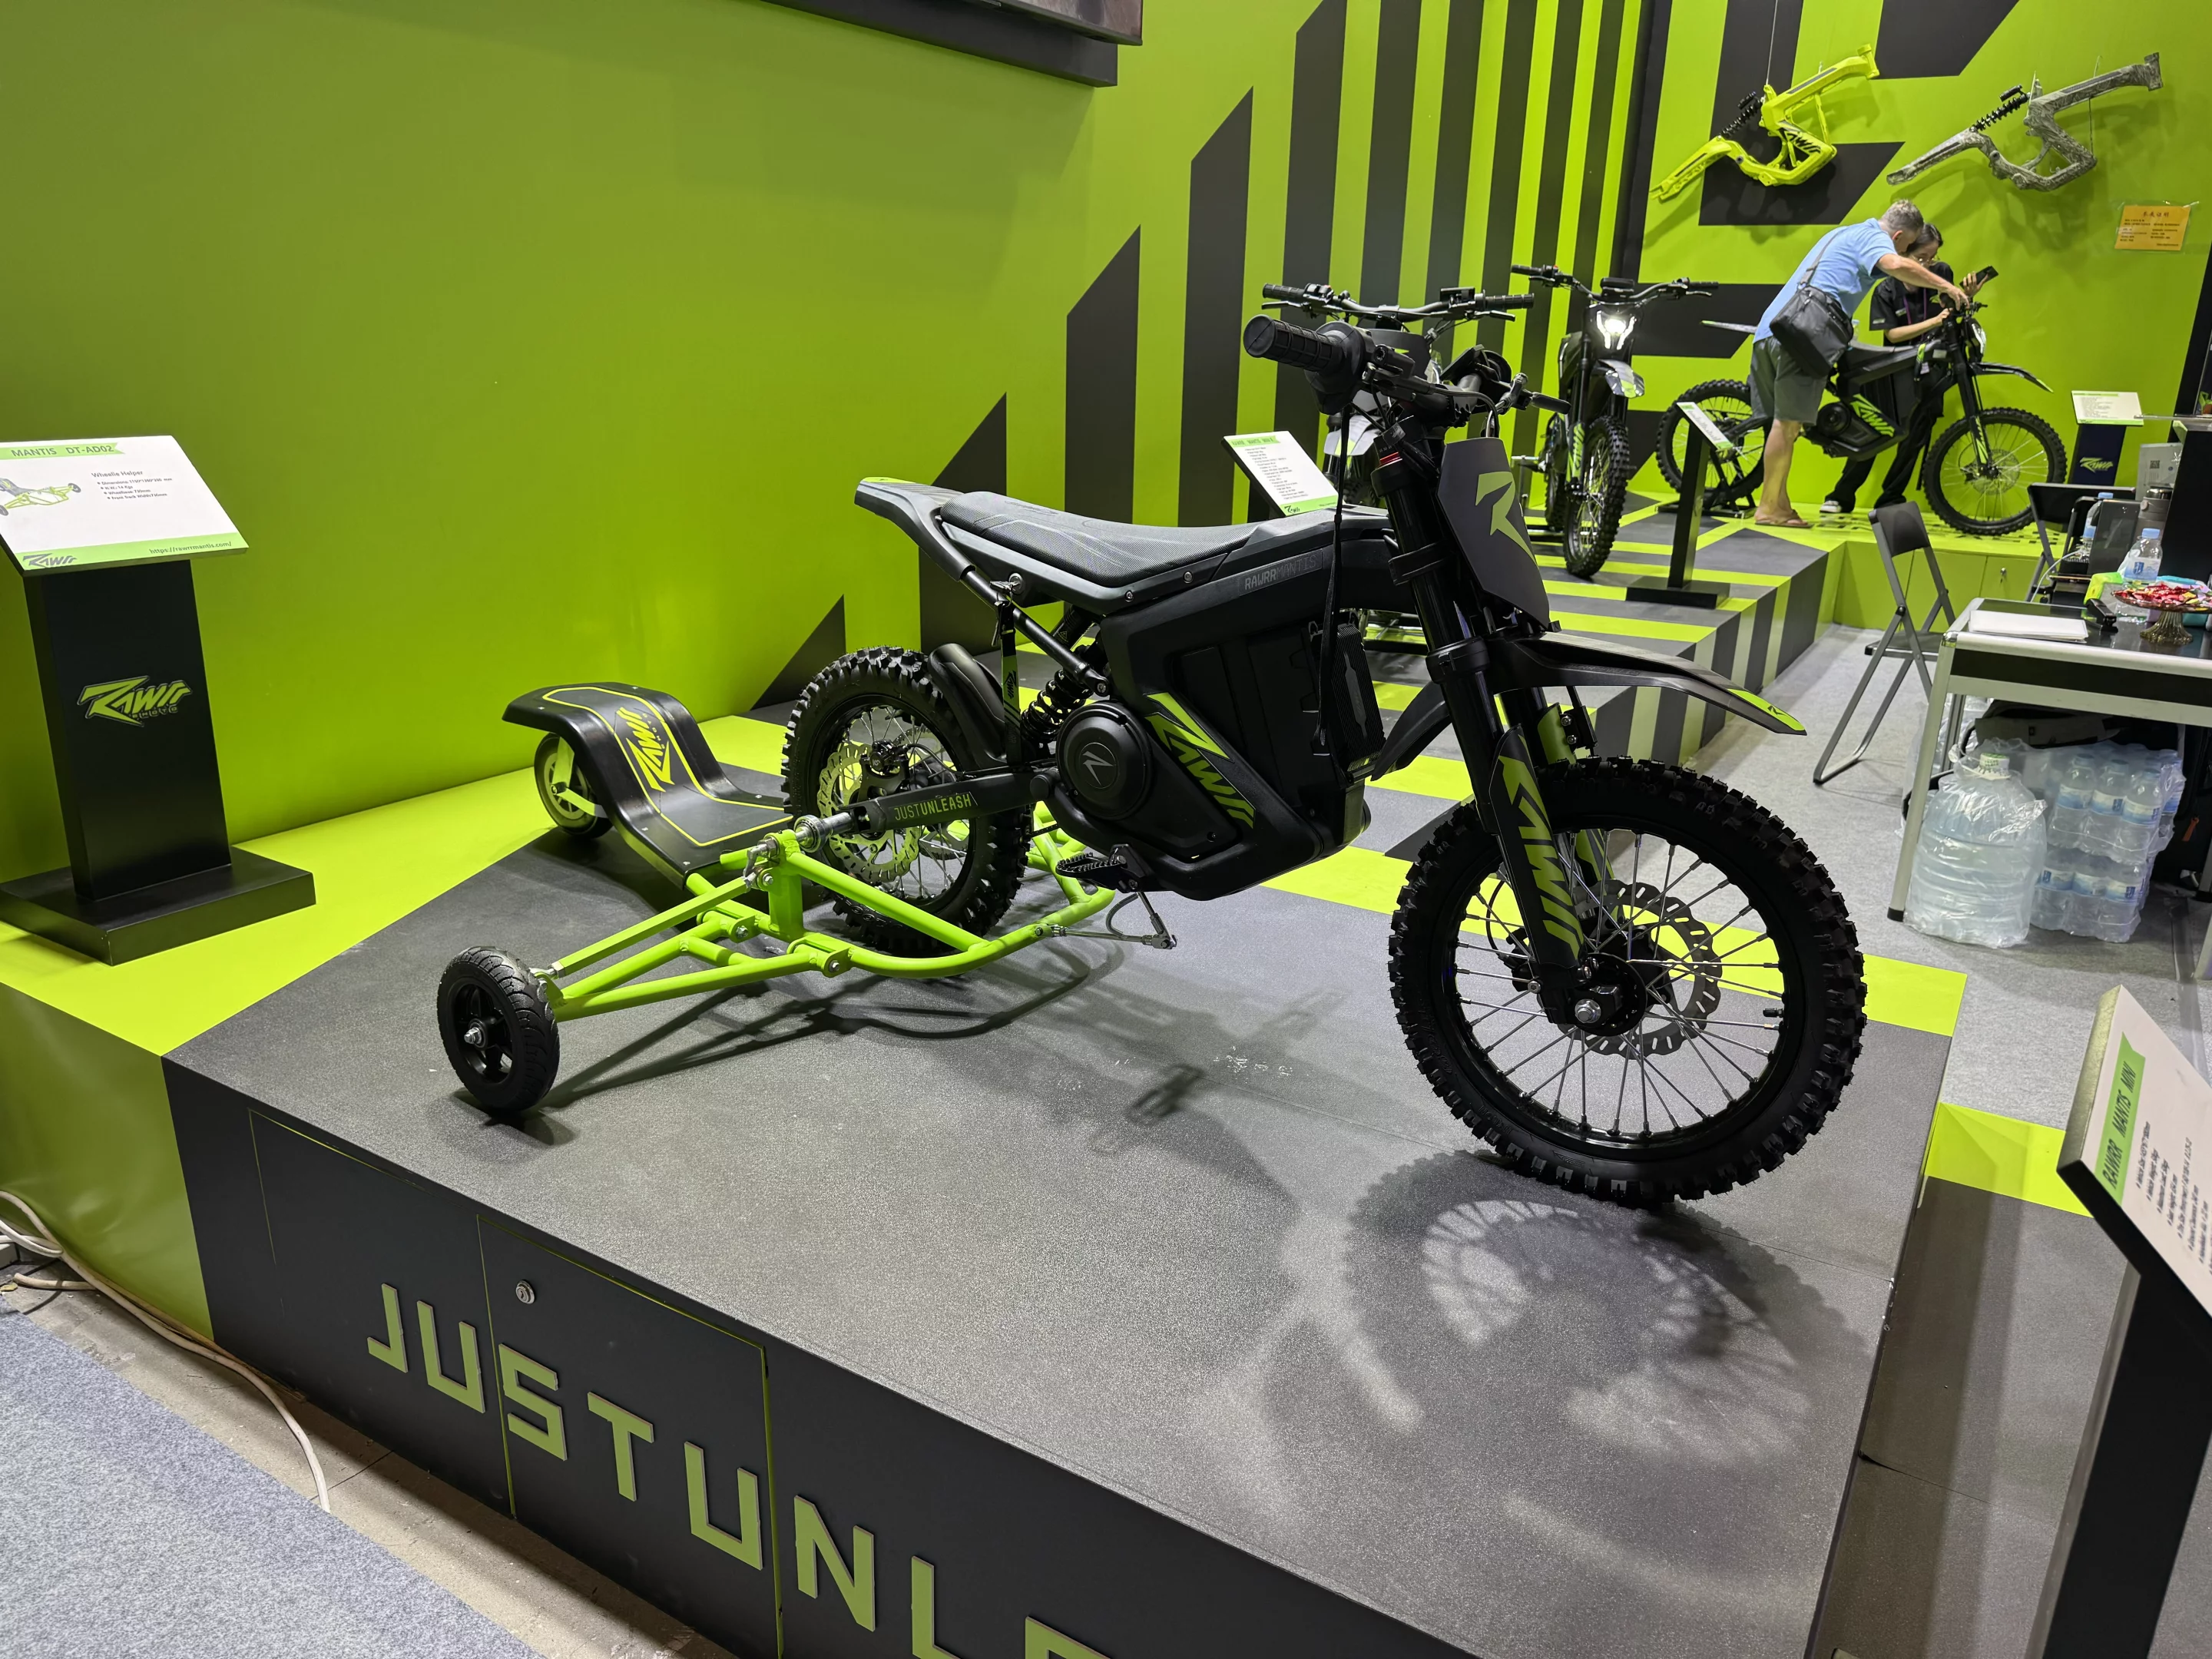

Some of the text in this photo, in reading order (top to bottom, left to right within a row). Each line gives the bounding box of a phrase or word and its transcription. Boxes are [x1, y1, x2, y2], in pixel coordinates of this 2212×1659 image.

[12, 445, 114, 457] MANTIS DT-AD02
[894, 793, 972, 820] JUSTUNLEASH
[2103, 1061, 2136, 1189] RAWRR MANTIS MINI
